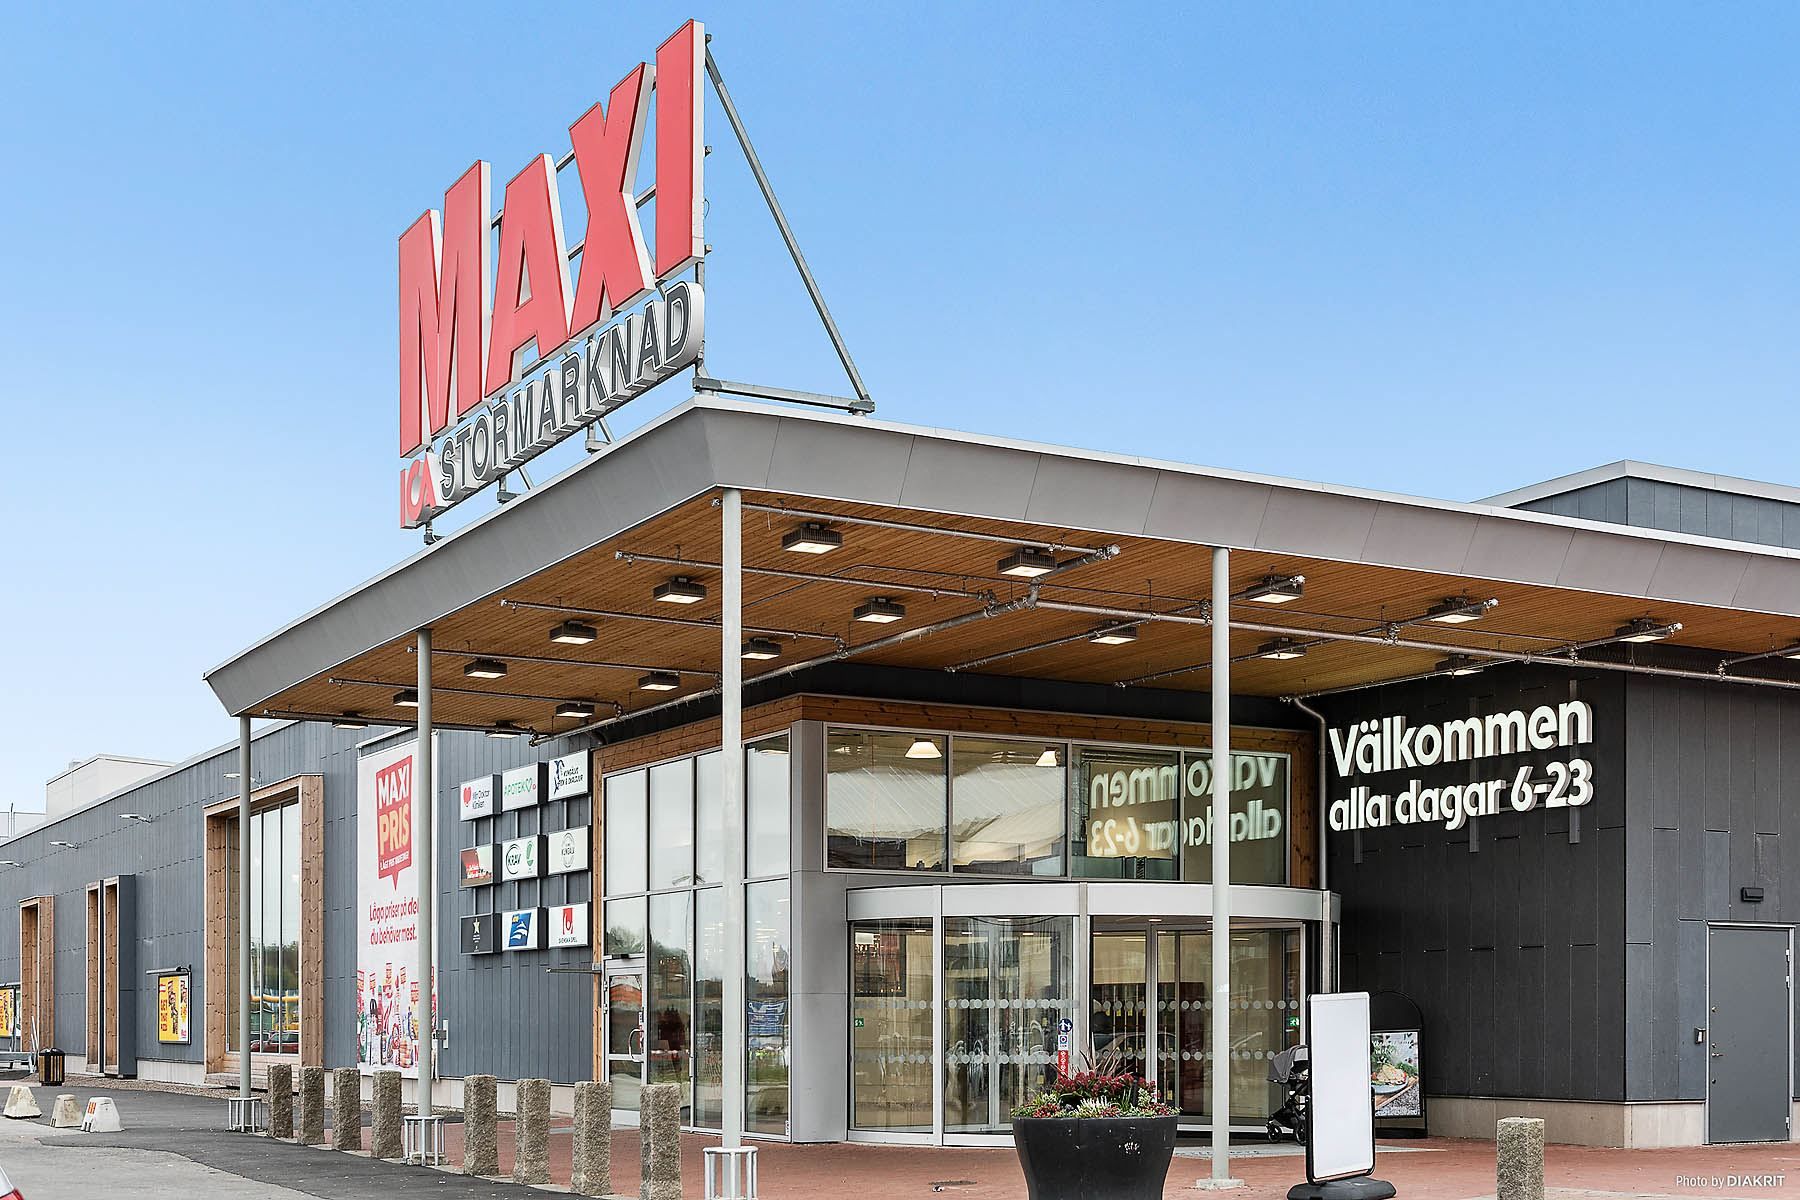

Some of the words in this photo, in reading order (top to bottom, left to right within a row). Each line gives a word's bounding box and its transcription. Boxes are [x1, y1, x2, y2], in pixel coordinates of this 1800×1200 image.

[398, 18, 706, 459] MAXI
[401, 457, 438, 529] ICA
[440, 281, 698, 500] STORMARKNAD
[1328, 700, 1592, 777] Välkommen
[377, 763, 410, 810] MAXI
[1329, 786, 1388, 832] alla
[1395, 779, 1504, 831] dagar
[1510, 758, 1593, 812] 6-23
[379, 803, 410, 855] PRIS
[508, 853, 521, 866] KRAV
[370, 928, 378, 945] du
[379, 926, 401, 944] behöver
